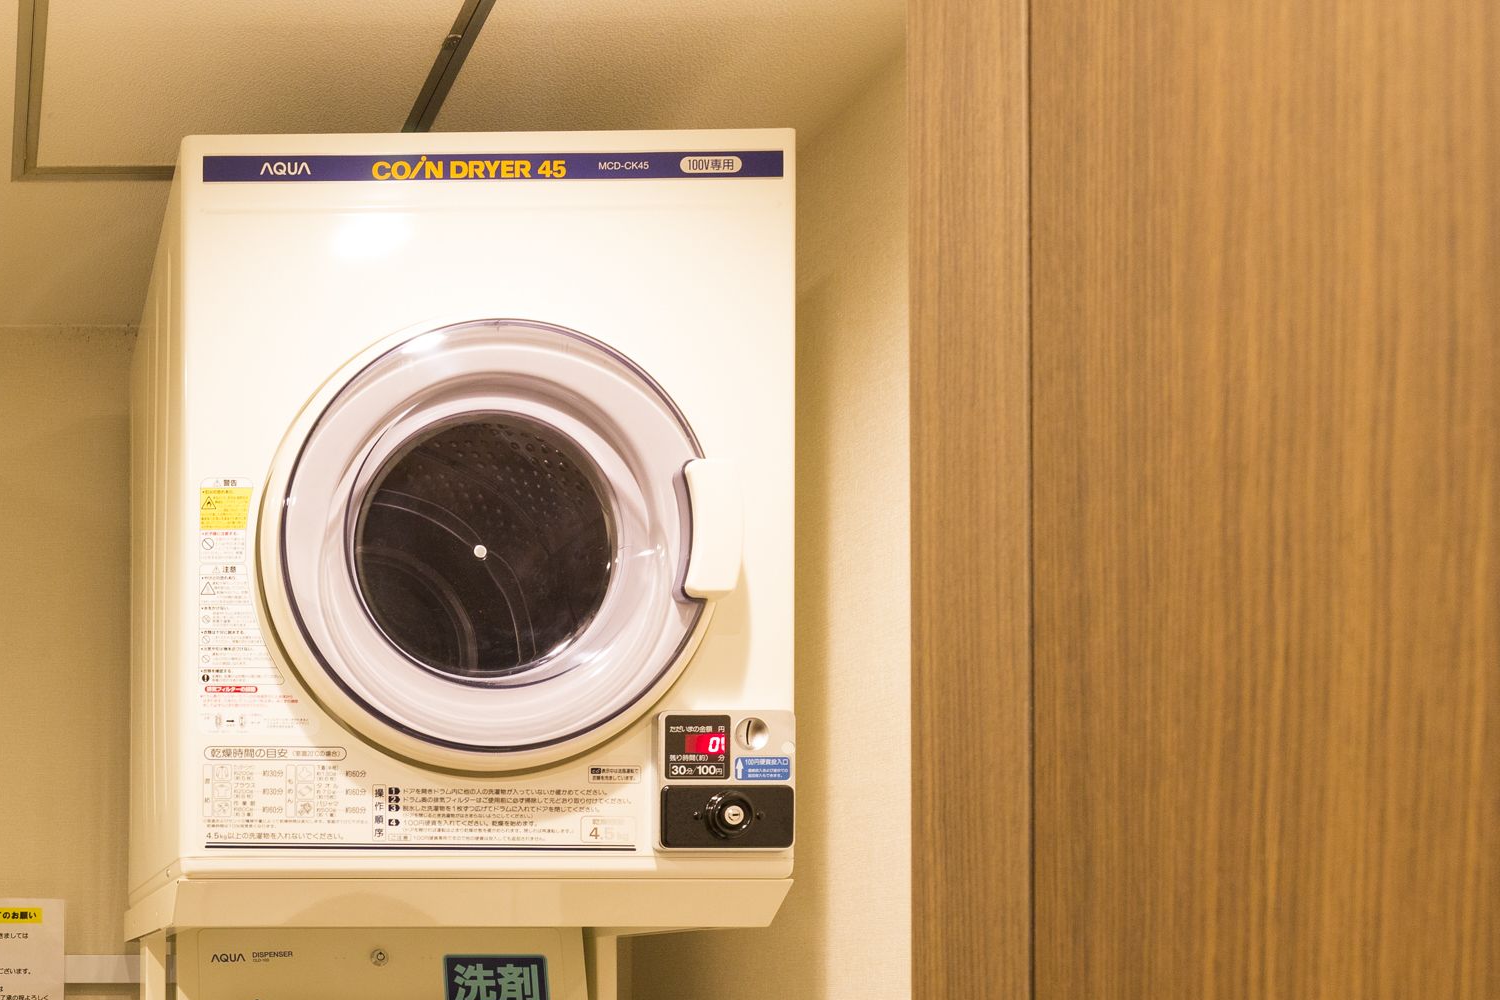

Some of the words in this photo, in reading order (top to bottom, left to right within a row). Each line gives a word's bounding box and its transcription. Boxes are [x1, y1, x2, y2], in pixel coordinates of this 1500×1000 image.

[260, 162, 311, 176] AQUA
[450, 160, 531, 178] DRYER
[537, 160, 567, 178] 45
[598, 161, 649, 170] MCD-CK45
[687, 159, 735, 171] 100V専用
[211, 748, 288, 759] 乾燥時間の目安
[671, 765, 723, 775] 30分/100円
[374, 789, 384, 837] 操作順序
[211, 953, 246, 963] AQUA
